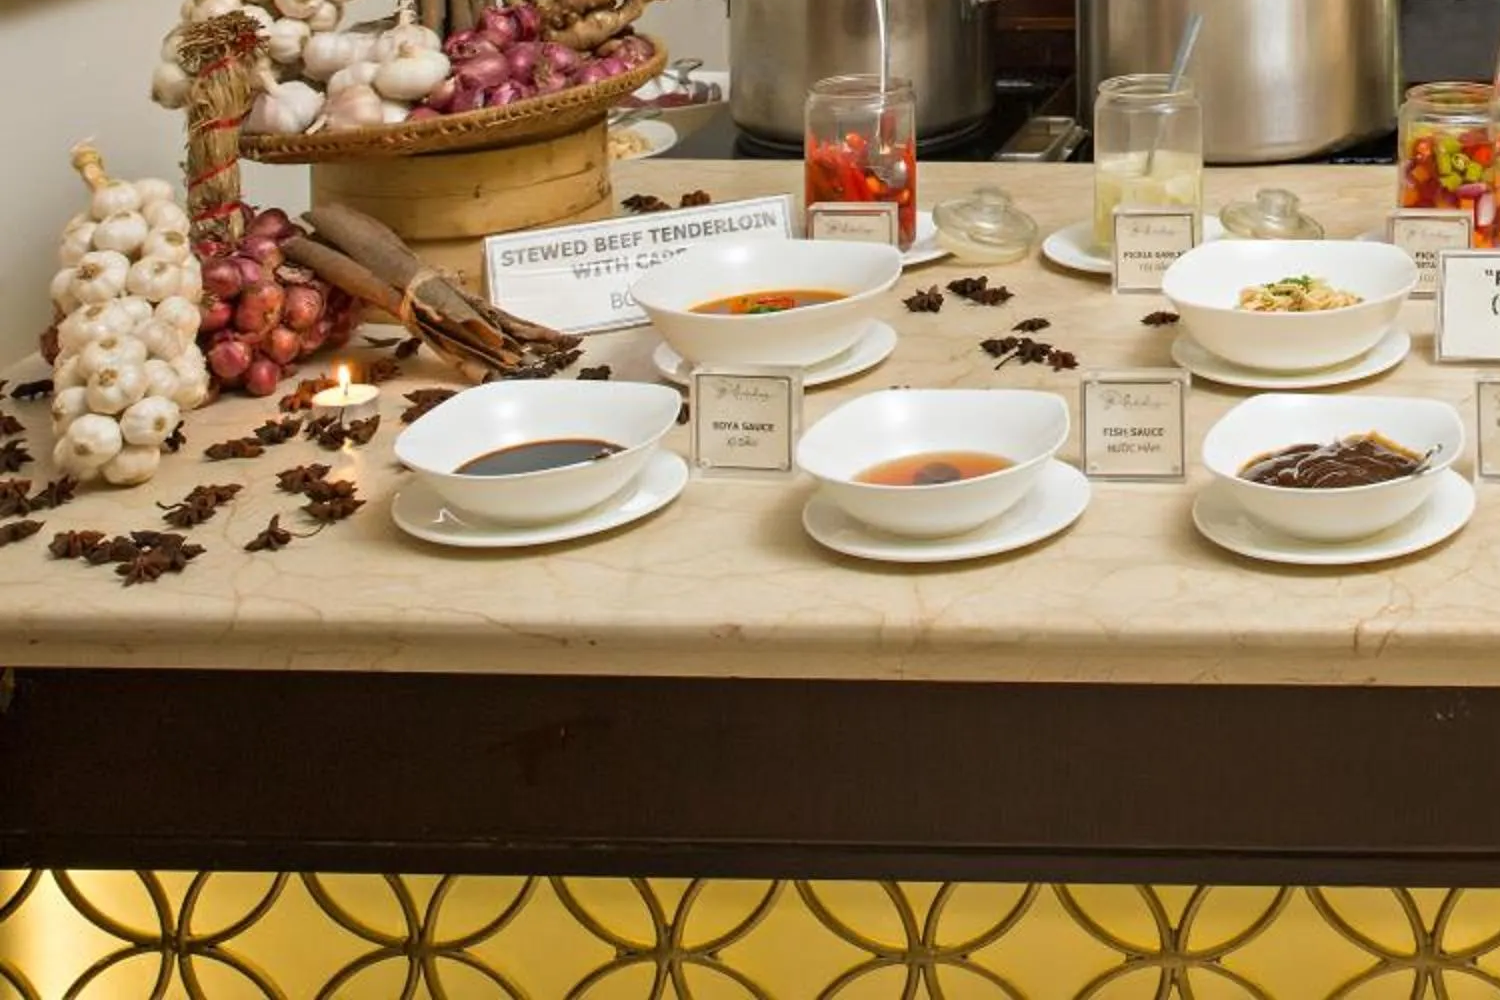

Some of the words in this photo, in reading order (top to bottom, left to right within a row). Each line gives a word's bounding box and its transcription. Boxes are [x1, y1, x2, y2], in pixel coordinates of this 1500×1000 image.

[501, 241, 587, 267] STEWED
[595, 231, 642, 253] BEEF
[648, 211, 777, 244] TENDERLOIN
[573, 256, 630, 279] WITH
[1103, 427, 1127, 436] FISH
[1130, 427, 1164, 437] SAUCE
